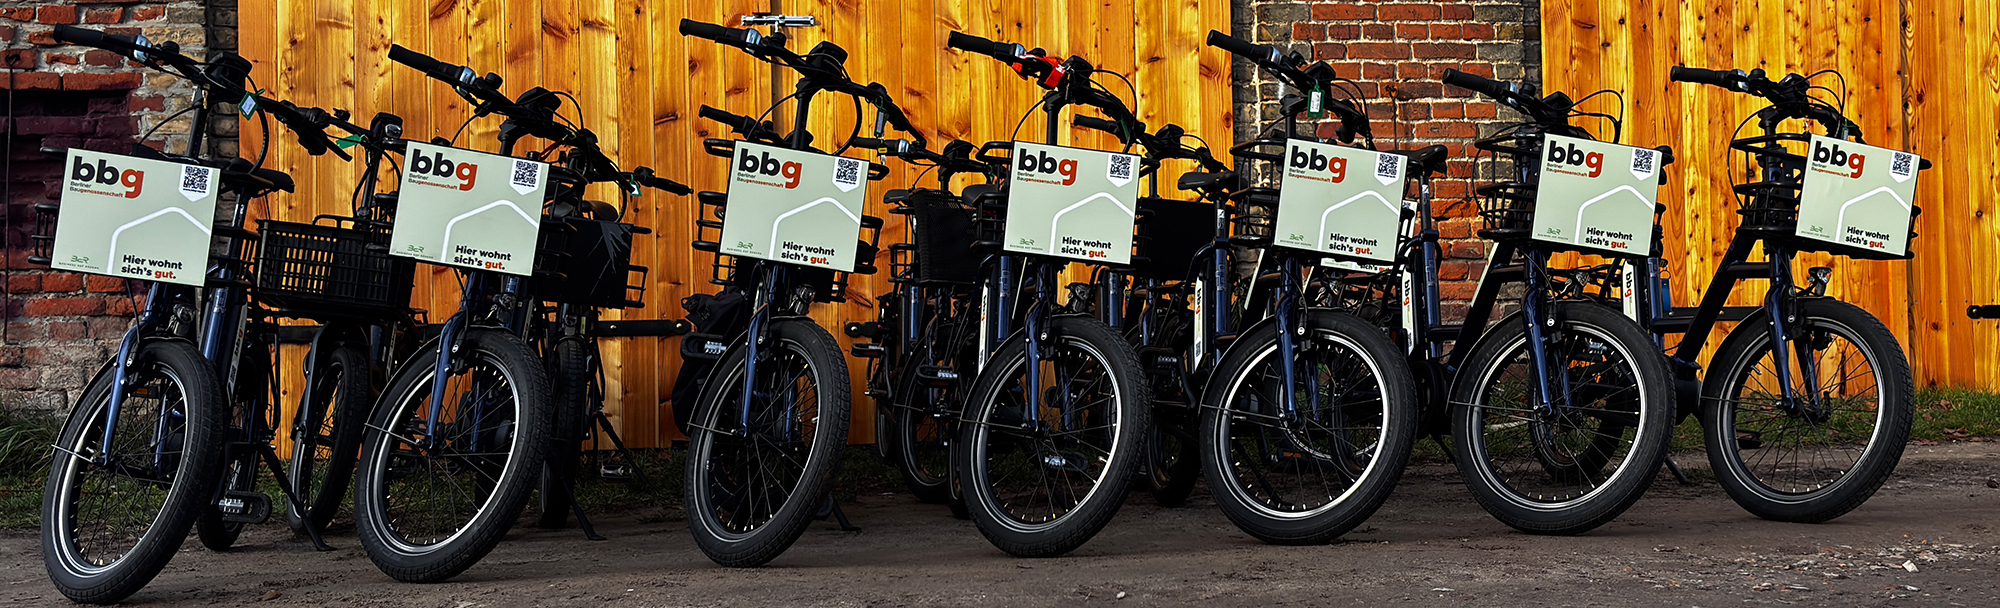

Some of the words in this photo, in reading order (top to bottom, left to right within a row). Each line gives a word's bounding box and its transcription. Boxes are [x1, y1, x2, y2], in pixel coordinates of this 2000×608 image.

[1290, 145, 1347, 183] bbg
[1548, 140, 1604, 178] bbg
[1813, 140, 1865, 179] bbg
[410, 149, 478, 191] bbg
[738, 148, 802, 189] bbg
[1018, 148, 1078, 186] bbg
[71, 156, 144, 199] bbg
[408, 178, 457, 190] Baugenossenschaft
[737, 177, 783, 188] Baugenossenschaft
[70, 187, 123, 197] Baugenossenschaft
[1330, 233, 1349, 242] Hier
[1350, 237, 1377, 246] wohnt
[1587, 227, 1605, 236] Hier
[1606, 231, 1632, 241] wohnt
[1847, 226, 1864, 236] Hier
[1865, 231, 1889, 241] wohnt
[783, 241, 803, 251] Hier
[805, 246, 835, 256] wohnt
[1062, 236, 1081, 246] Hier
[1083, 240, 1111, 249] wohnt
[1329, 242, 1353, 252] sich's
[1355, 247, 1372, 255] gut.
[1585, 236, 1609, 246] sich's
[1611, 241, 1628, 249] gut.
[1845, 235, 1867, 245] sich's
[1869, 241, 1885, 249] gut.
[456, 245, 477, 255] Hier
[479, 250, 511, 261] wohnt
[781, 251, 808, 262] sich's
[810, 257, 829, 265] gut.
[1061, 246, 1087, 256] sich's
[1089, 250, 1107, 258] gut.
[123, 255, 146, 265] Hier
[148, 259, 182, 270] wohnt
[454, 255, 483, 266] sich's
[485, 261, 505, 270] gut.
[121, 265, 152, 276] sich's
[155, 271, 176, 279] gut.
